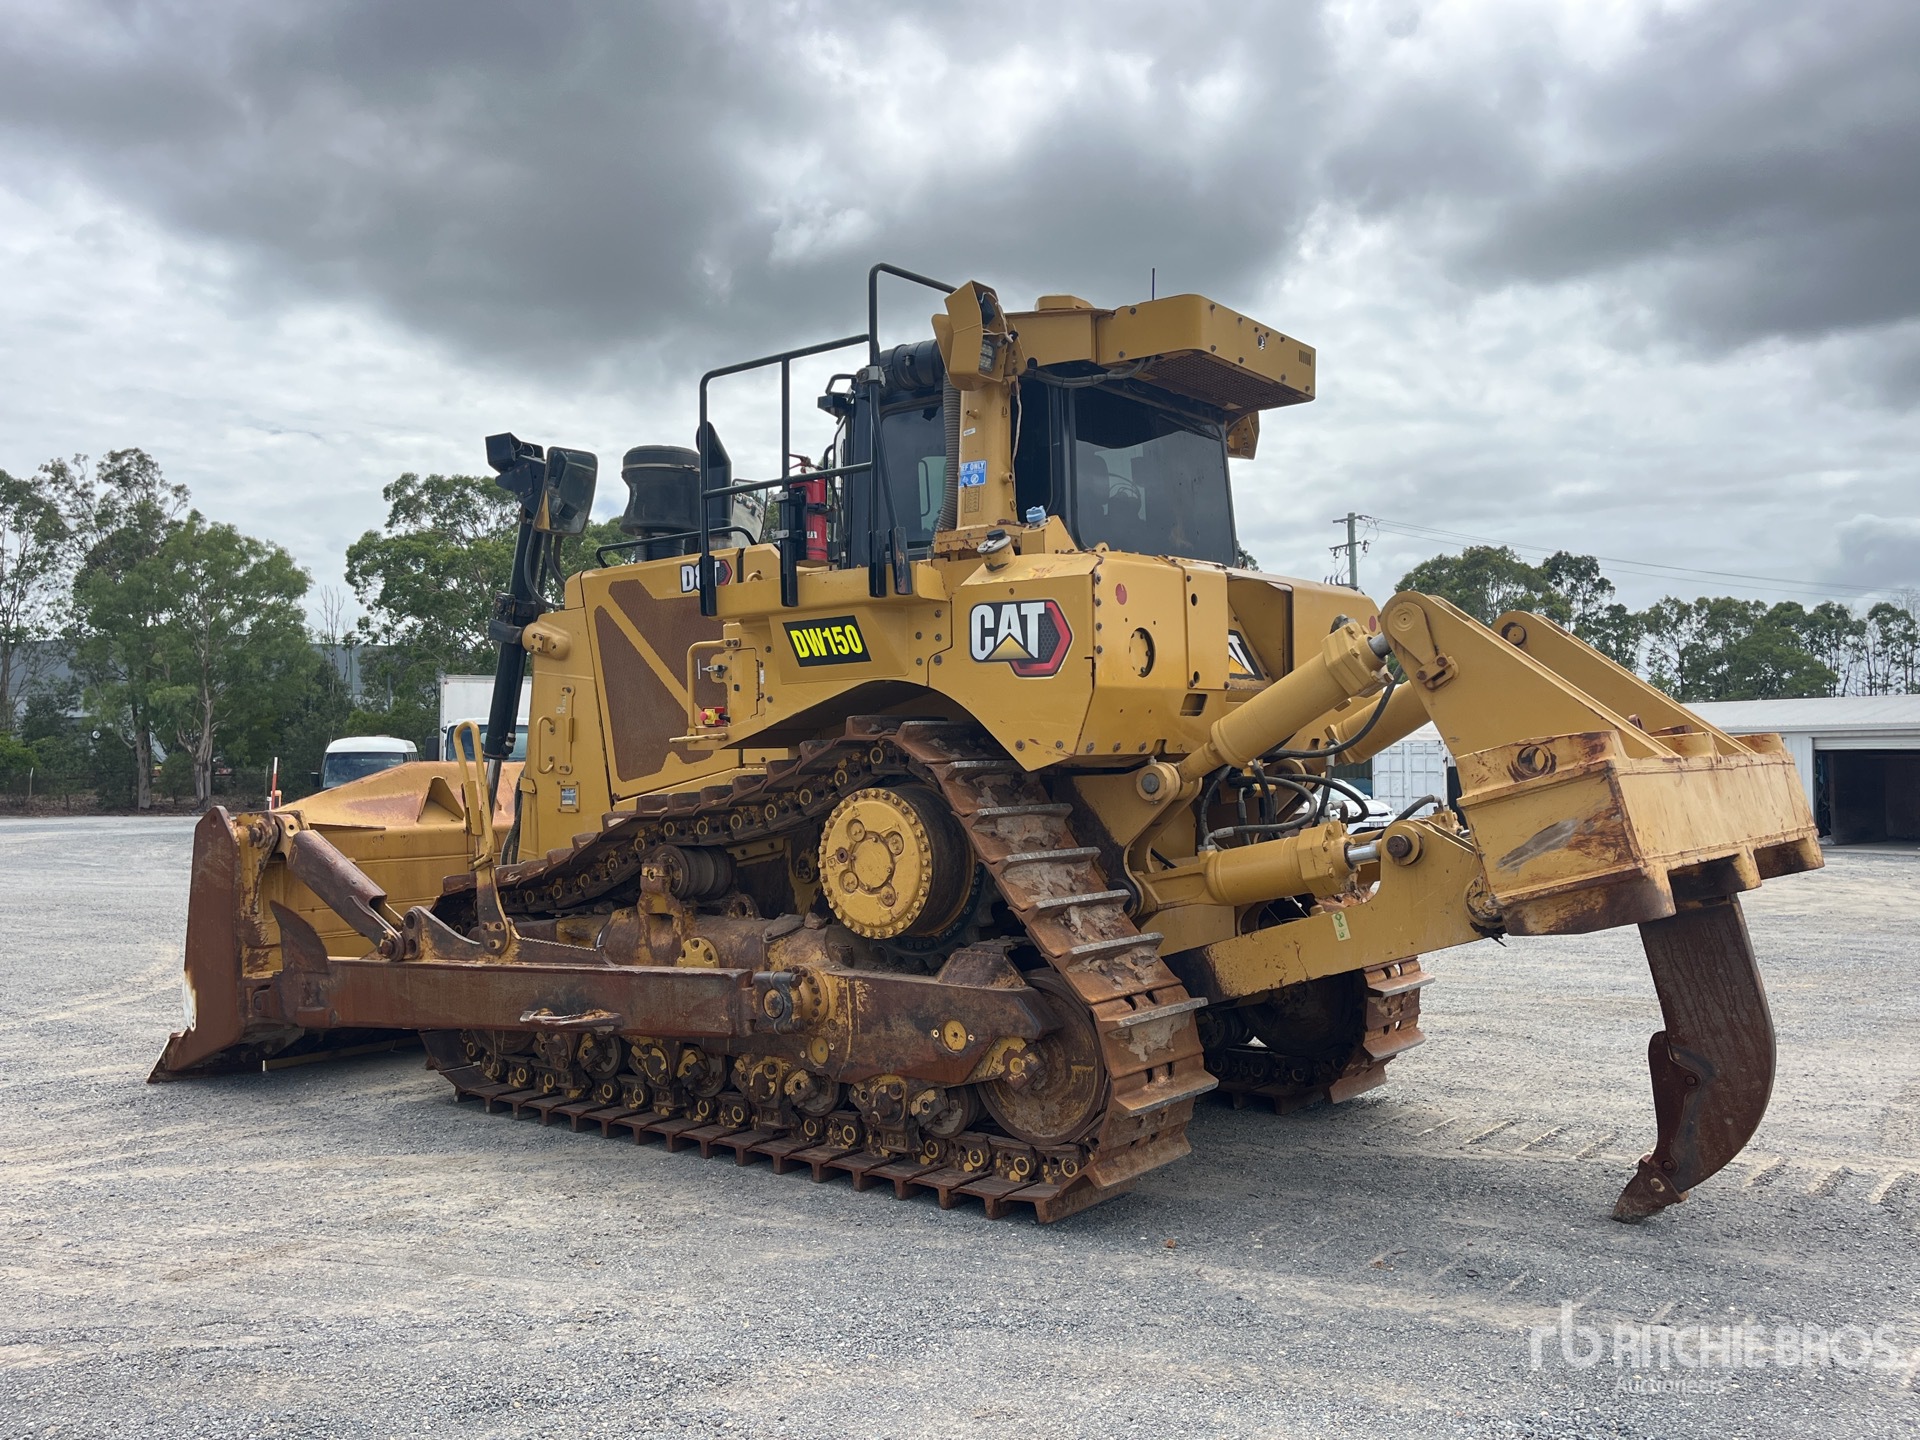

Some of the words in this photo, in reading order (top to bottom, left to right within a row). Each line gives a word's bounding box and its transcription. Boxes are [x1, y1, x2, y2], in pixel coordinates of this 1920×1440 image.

[970, 462, 985, 471] ONLY
[789, 624, 863, 659] DW150
[971, 602, 1045, 660] CAT
